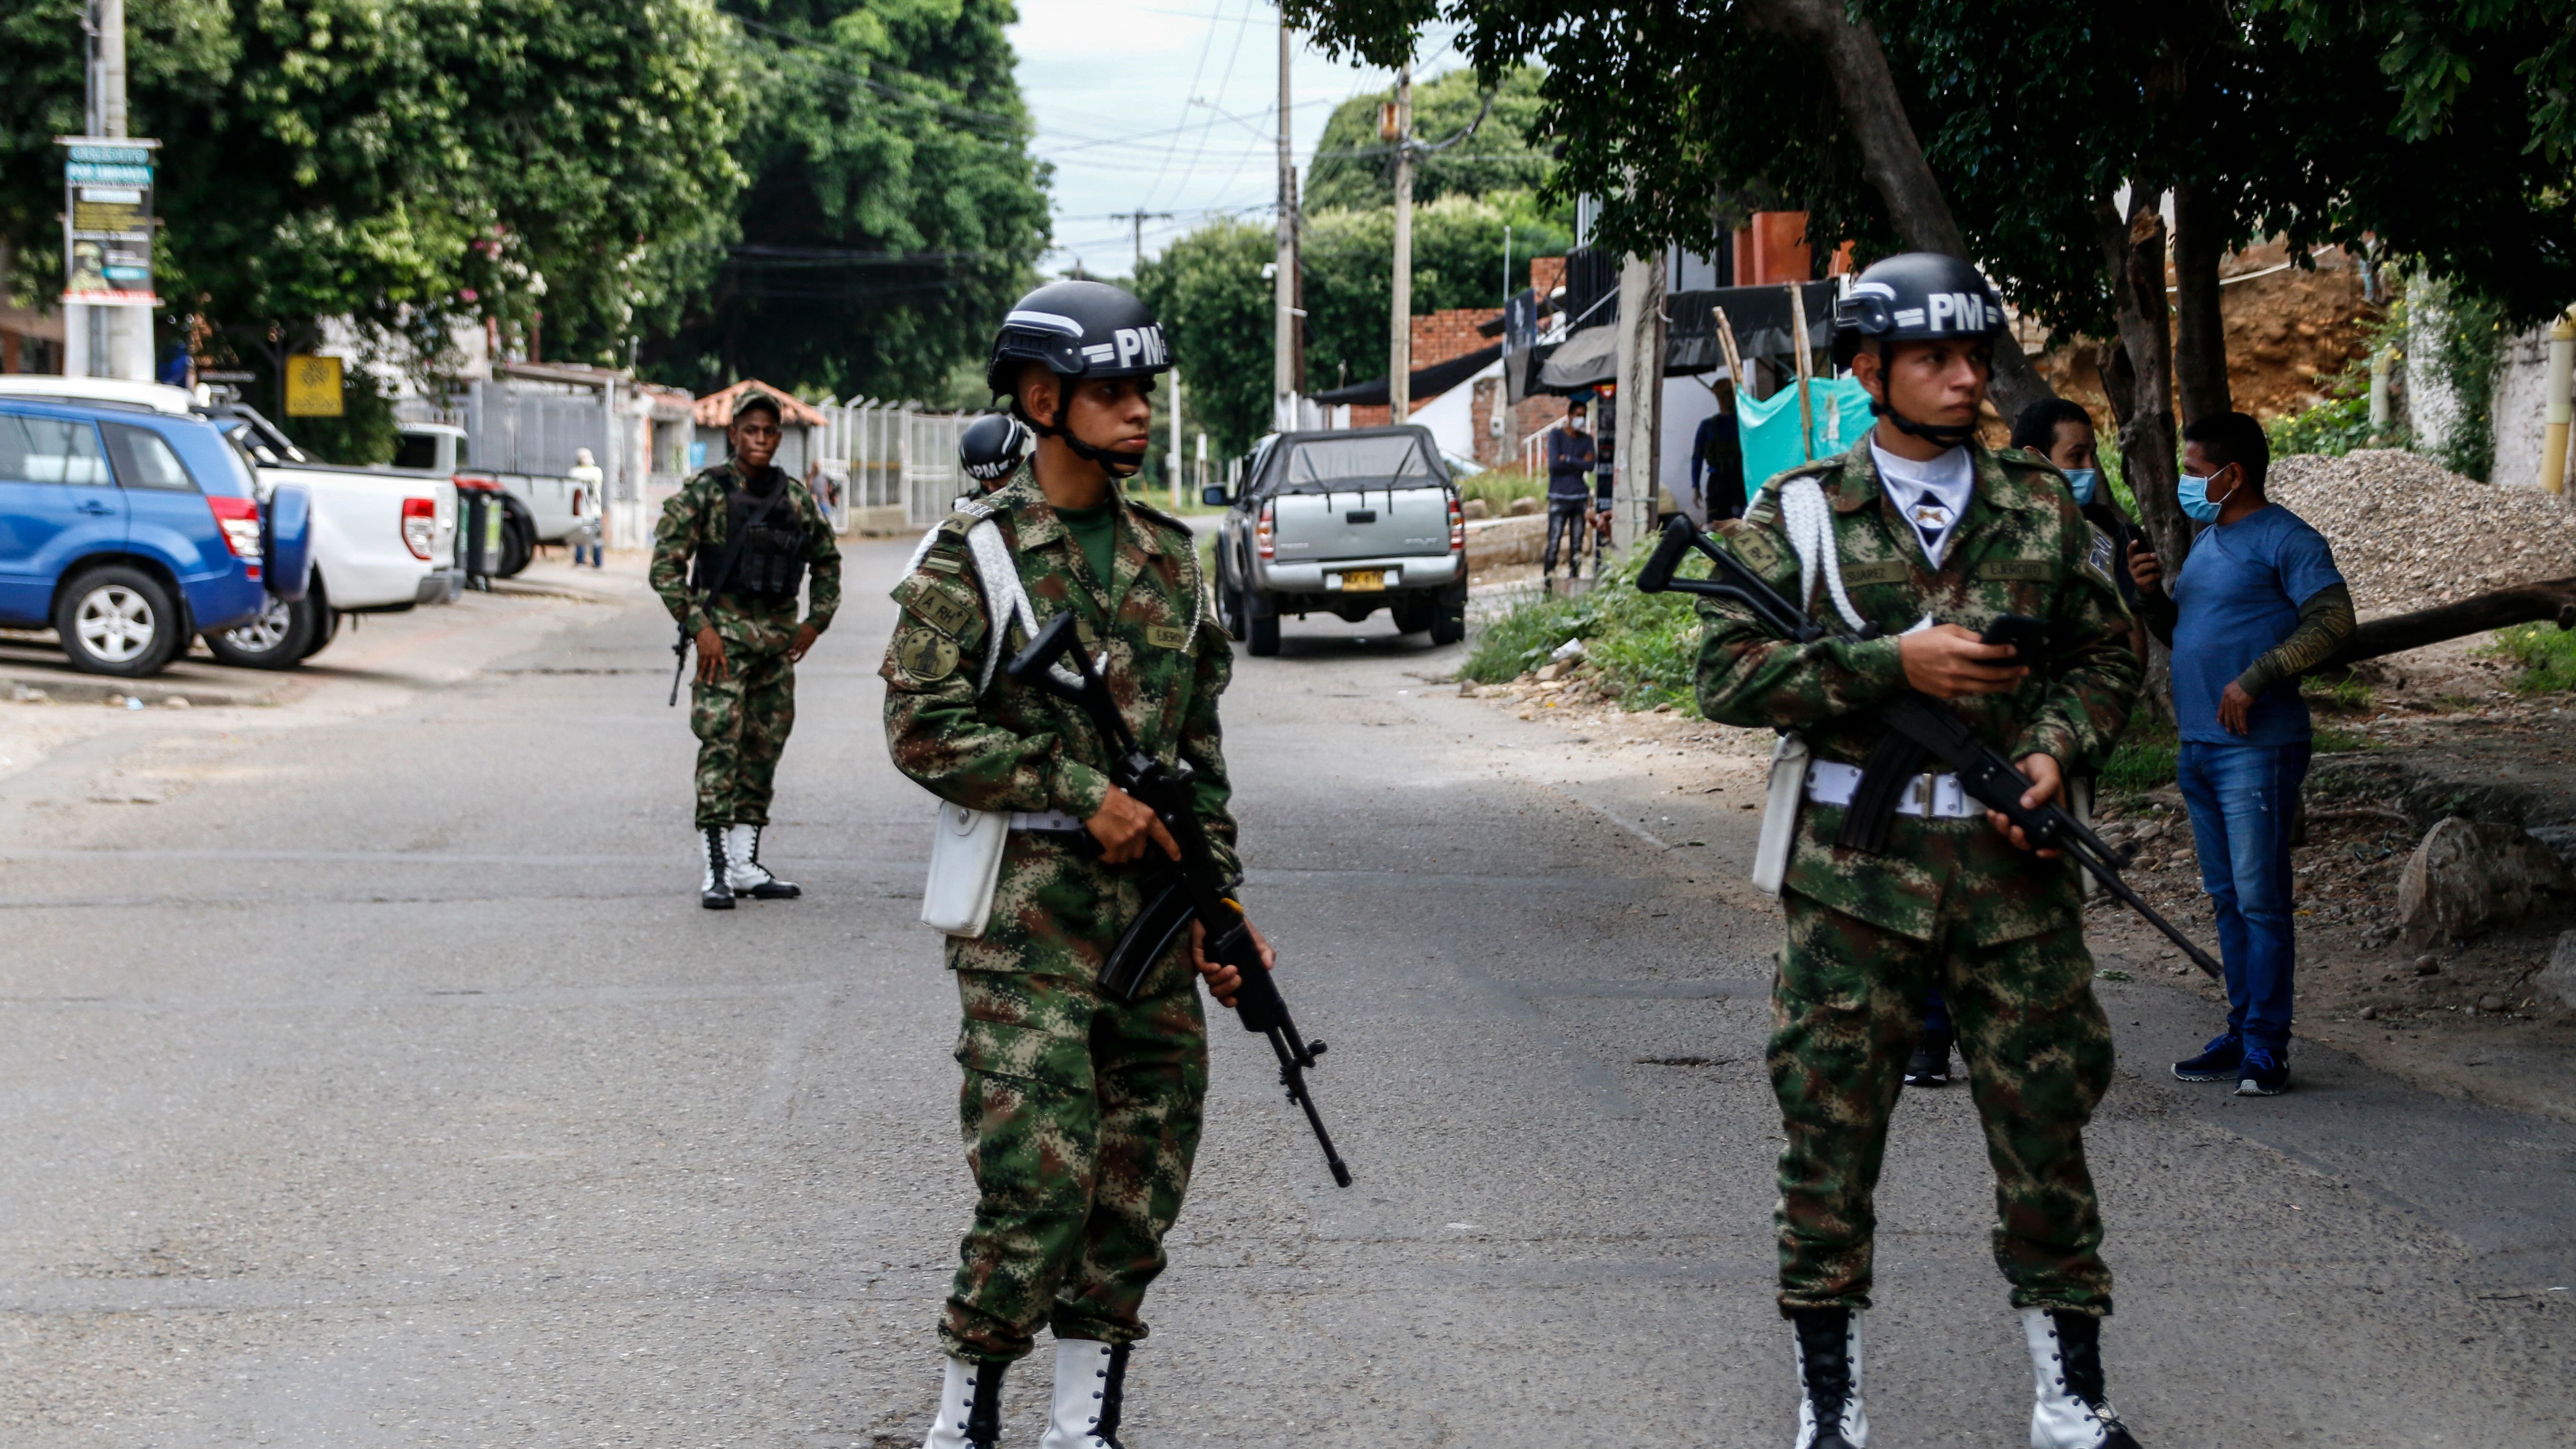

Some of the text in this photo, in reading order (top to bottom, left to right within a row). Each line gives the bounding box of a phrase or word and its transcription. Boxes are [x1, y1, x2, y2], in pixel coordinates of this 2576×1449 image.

[1929, 293, 1985, 331] PM
[1115, 326, 1164, 368] PM
[973, 461, 999, 478] PM
[1738, 538, 1750, 547] A
[2089, 530, 2112, 581] PM
[922, 596, 934, 610] A
